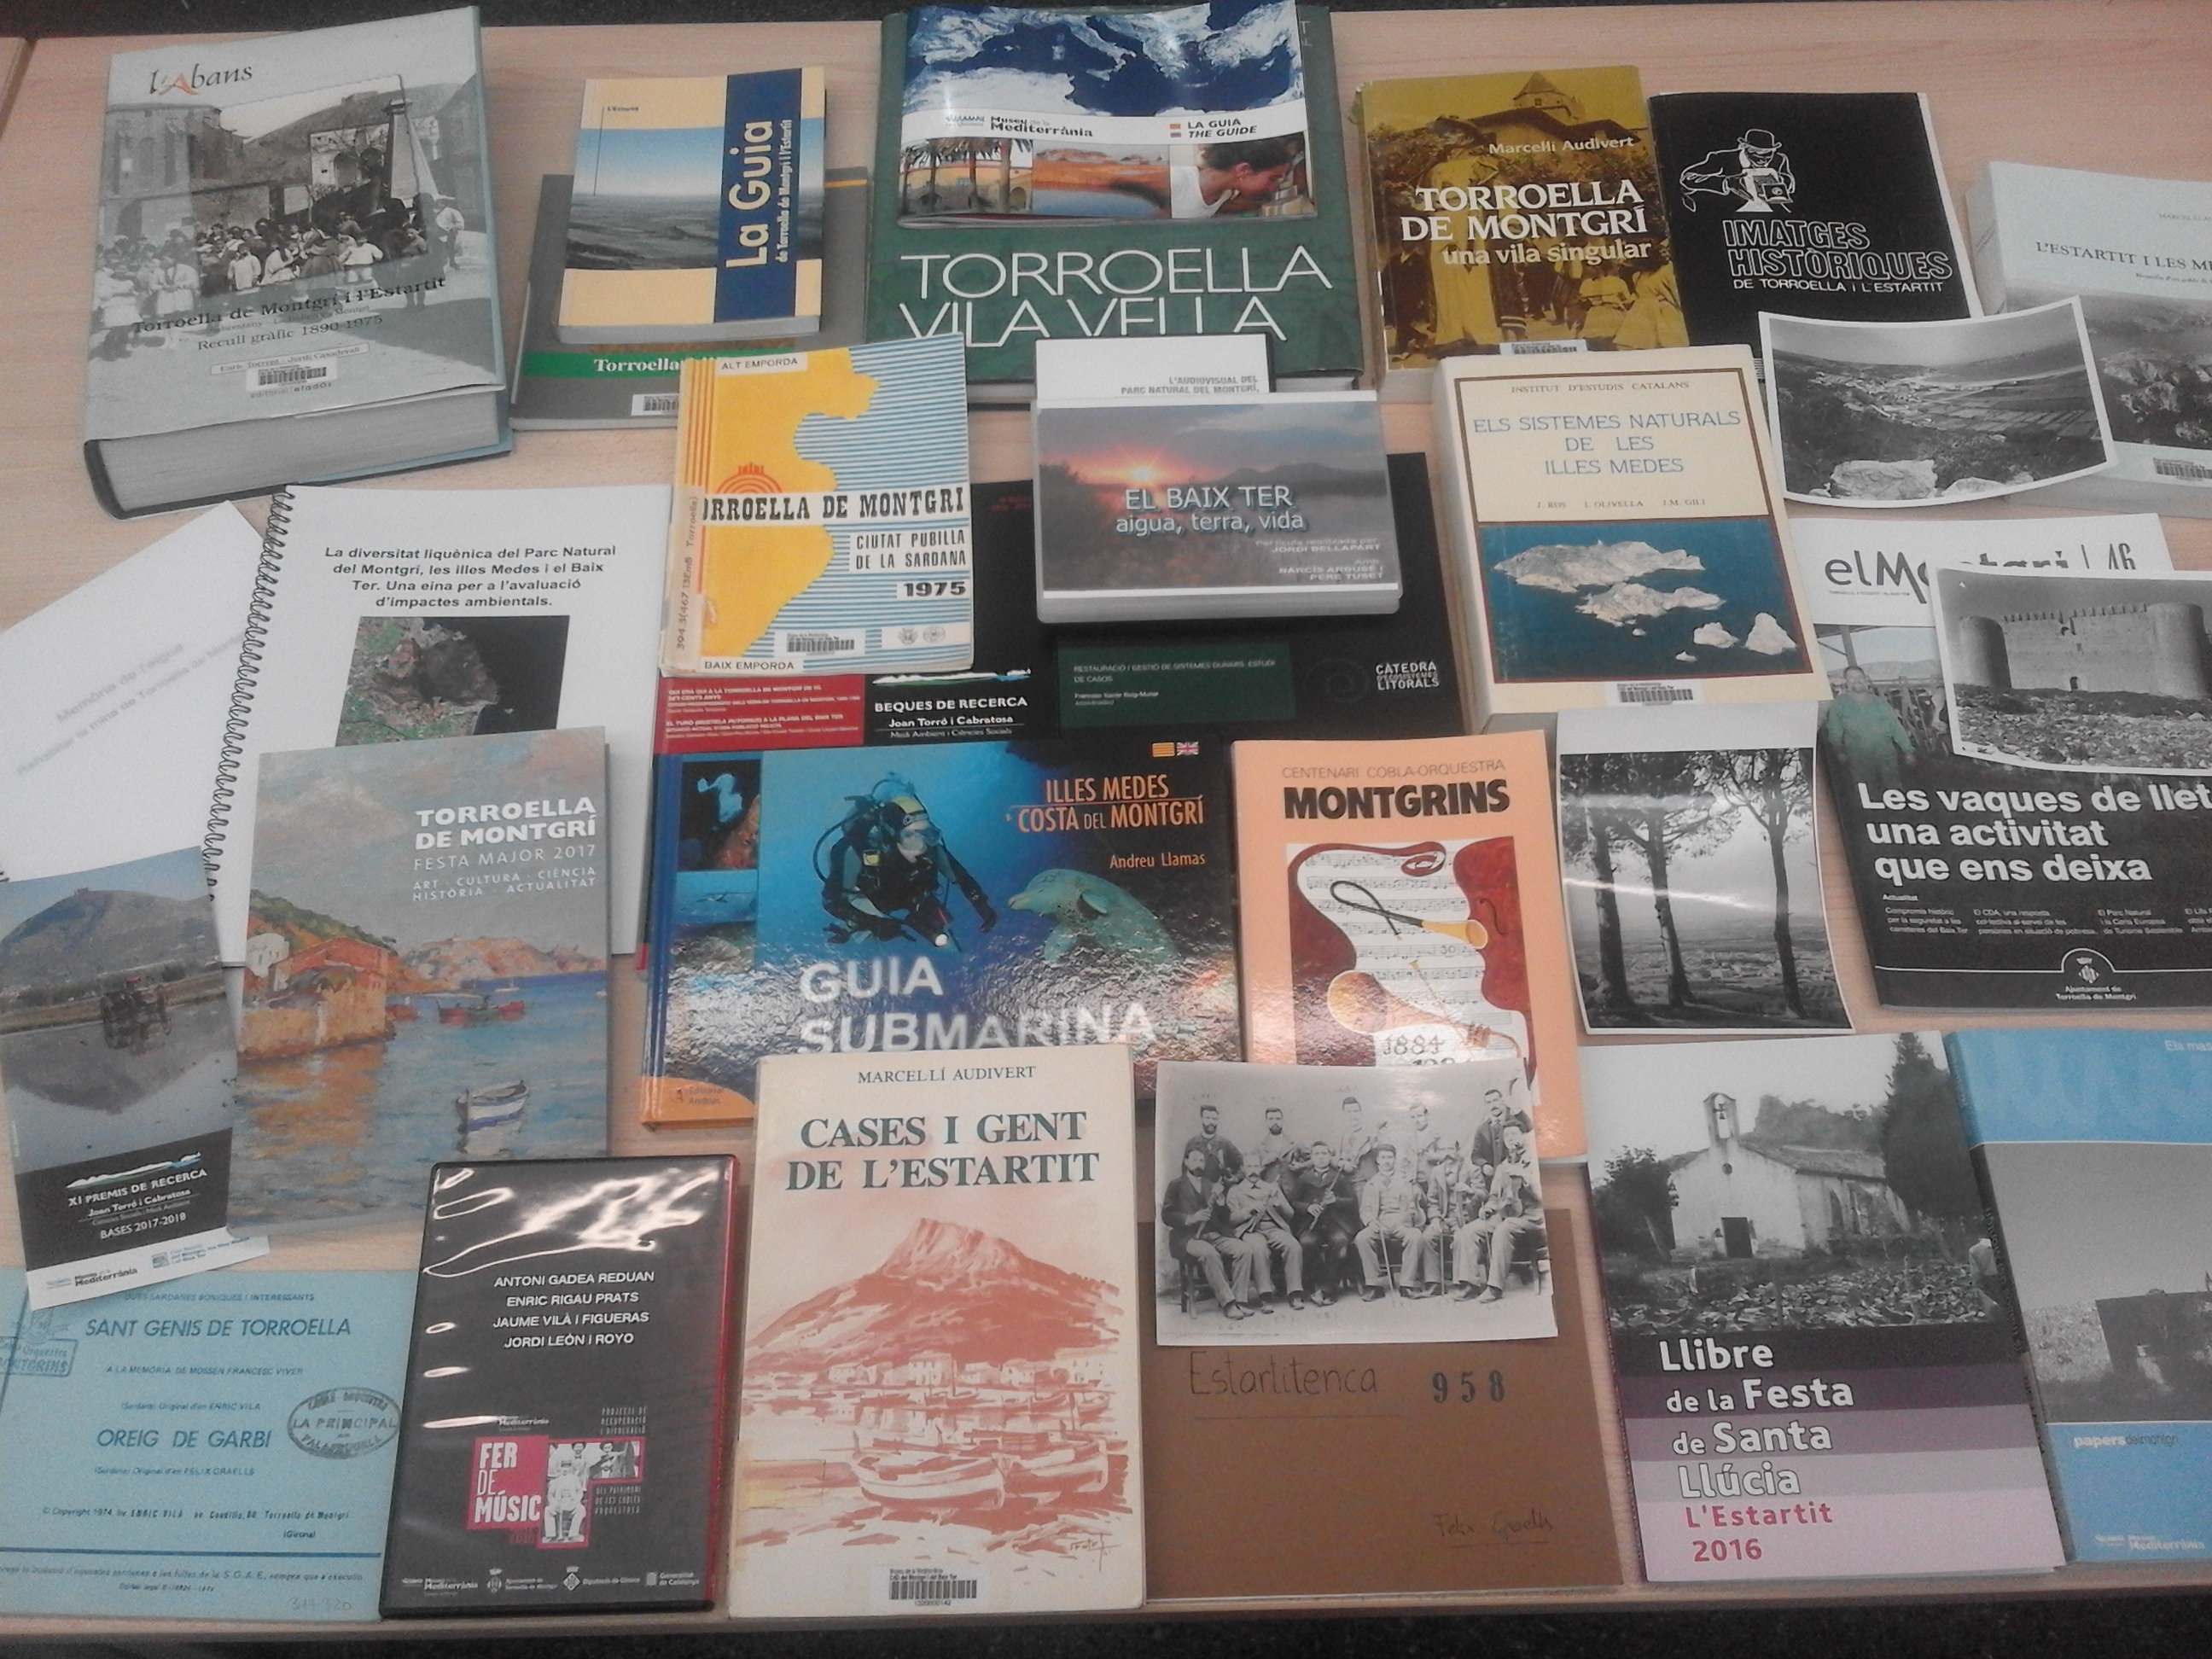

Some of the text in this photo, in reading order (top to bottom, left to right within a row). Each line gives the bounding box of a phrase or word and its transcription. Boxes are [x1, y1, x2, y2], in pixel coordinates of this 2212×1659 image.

[1217, 125, 1257, 137] GUIDE
[1562, 137, 1634, 151] Audivert
[725, 120, 772, 268] La Guia
[1415, 179, 1644, 212] TORROELLA
[1400, 205, 1649, 242] DE MONTGRÍ
[1721, 218, 1871, 251] IMATGES
[1443, 240, 1652, 267] una vila singular
[1728, 242, 1953, 282] HISTÒRIQUES
[2035, 241, 2136, 265] L'ESTARTIT
[900, 245, 1333, 300] TORROELLA
[1732, 278, 1944, 294] DE TORROELLA L'ESTARTIT
[133, 312, 222, 333] Torroella
[899, 300, 1051, 348] VILA
[199, 334, 246, 351] Recull
[594, 358, 680, 374] Torroella
[721, 357, 799, 370] ALT EMPORDA
[1121, 386, 1190, 396] PARC NATURAL
[1631, 381, 1690, 392] CATALANS
[1473, 410, 1742, 434] ELS SISTEMES NATURALS
[1565, 436, 1655, 452] DE LES
[1545, 457, 1685, 475] ILLES MEDES
[823, 496, 848, 519] DE
[859, 486, 964, 518] MONTGRI
[1125, 486, 1295, 511] EL BAIX TER
[1115, 509, 1305, 538] aigua, terra, vida
[856, 529, 965, 550] CIUTAT PUBILLA
[325, 544, 616, 562] La diversitat liquènica del Parc Natural
[855, 550, 967, 570] DE LA SARDANA
[333, 562, 605, 575] del les illes Medes Baix
[352, 578, 582, 594] Ter. Una eina per l'avaluació
[903, 581, 967, 597] 1975
[375, 595, 553, 610] d'impactes ambientals.
[704, 660, 795, 671] BAIX EMPORDA
[1377, 678, 1440, 690] LITORALS
[874, 701, 934, 713] BEQUES
[935, 700, 957, 711] DE
[958, 696, 1028, 710] RECERCA
[888, 714, 1015, 729] Joan Cabratosa
[1282, 759, 1506, 780] CENTENARI COBLA-ORQUESTRA
[1045, 773, 1169, 804] ILLES MEDES
[1284, 778, 1511, 820] MONTGRINS
[416, 797, 597, 828] TORROELLA
[1857, 783, 2212, 819] Les vaques de llet
[1016, 795, 1205, 834] COSTA DEL MONTGRÍ
[416, 814, 597, 851] DE MONTGRÍ
[1866, 818, 2110, 848] una activitat
[414, 843, 597, 871] FESTA MAJOR 2017
[1109, 852, 1207, 870] Andreu Llamas
[1874, 853, 2153, 886] que ens deixa
[413, 872, 521, 892] ART CULTURA
[505, 876, 597, 894] ACTUALITAT
[800, 955, 945, 1004] GUIA
[952, 1065, 1037, 1080] AUDIVERT
[800, 1110, 1088, 1149] CASES I GENT
[786, 1152, 1101, 1191] DE L'ESTARTIT
[84, 1168, 208, 1204] PREMIS DE RECERCA
[100, 1212, 187, 1240] BASES 2017-2018
[493, 1270, 655, 1289] ANTONI GADEA REDUAN
[506, 1290, 640, 1308] ENRIC RIGAU PRATS
[84, 1318, 352, 1337] SANT GENIS DE TORROELLA
[493, 1311, 650, 1329] JAUME VILÀ FIGUERAS
[504, 1331, 635, 1349] JORDI LEÓN ROYO
[1659, 1336, 1775, 1373] Llibre
[1666, 1377, 1855, 1414] de la Festa
[96, 1429, 271, 1448] OREIG DE GARBI
[1672, 1418, 1834, 1456] de Santa
[479, 1441, 519, 1470] FER
[477, 1469, 499, 1496] DE
[1677, 1460, 1802, 1500] Llúcia
[474, 1488, 543, 1523] MÚSIC
[1685, 1500, 1835, 1529] L'Estartit
[1692, 1537, 1763, 1563] 2016
